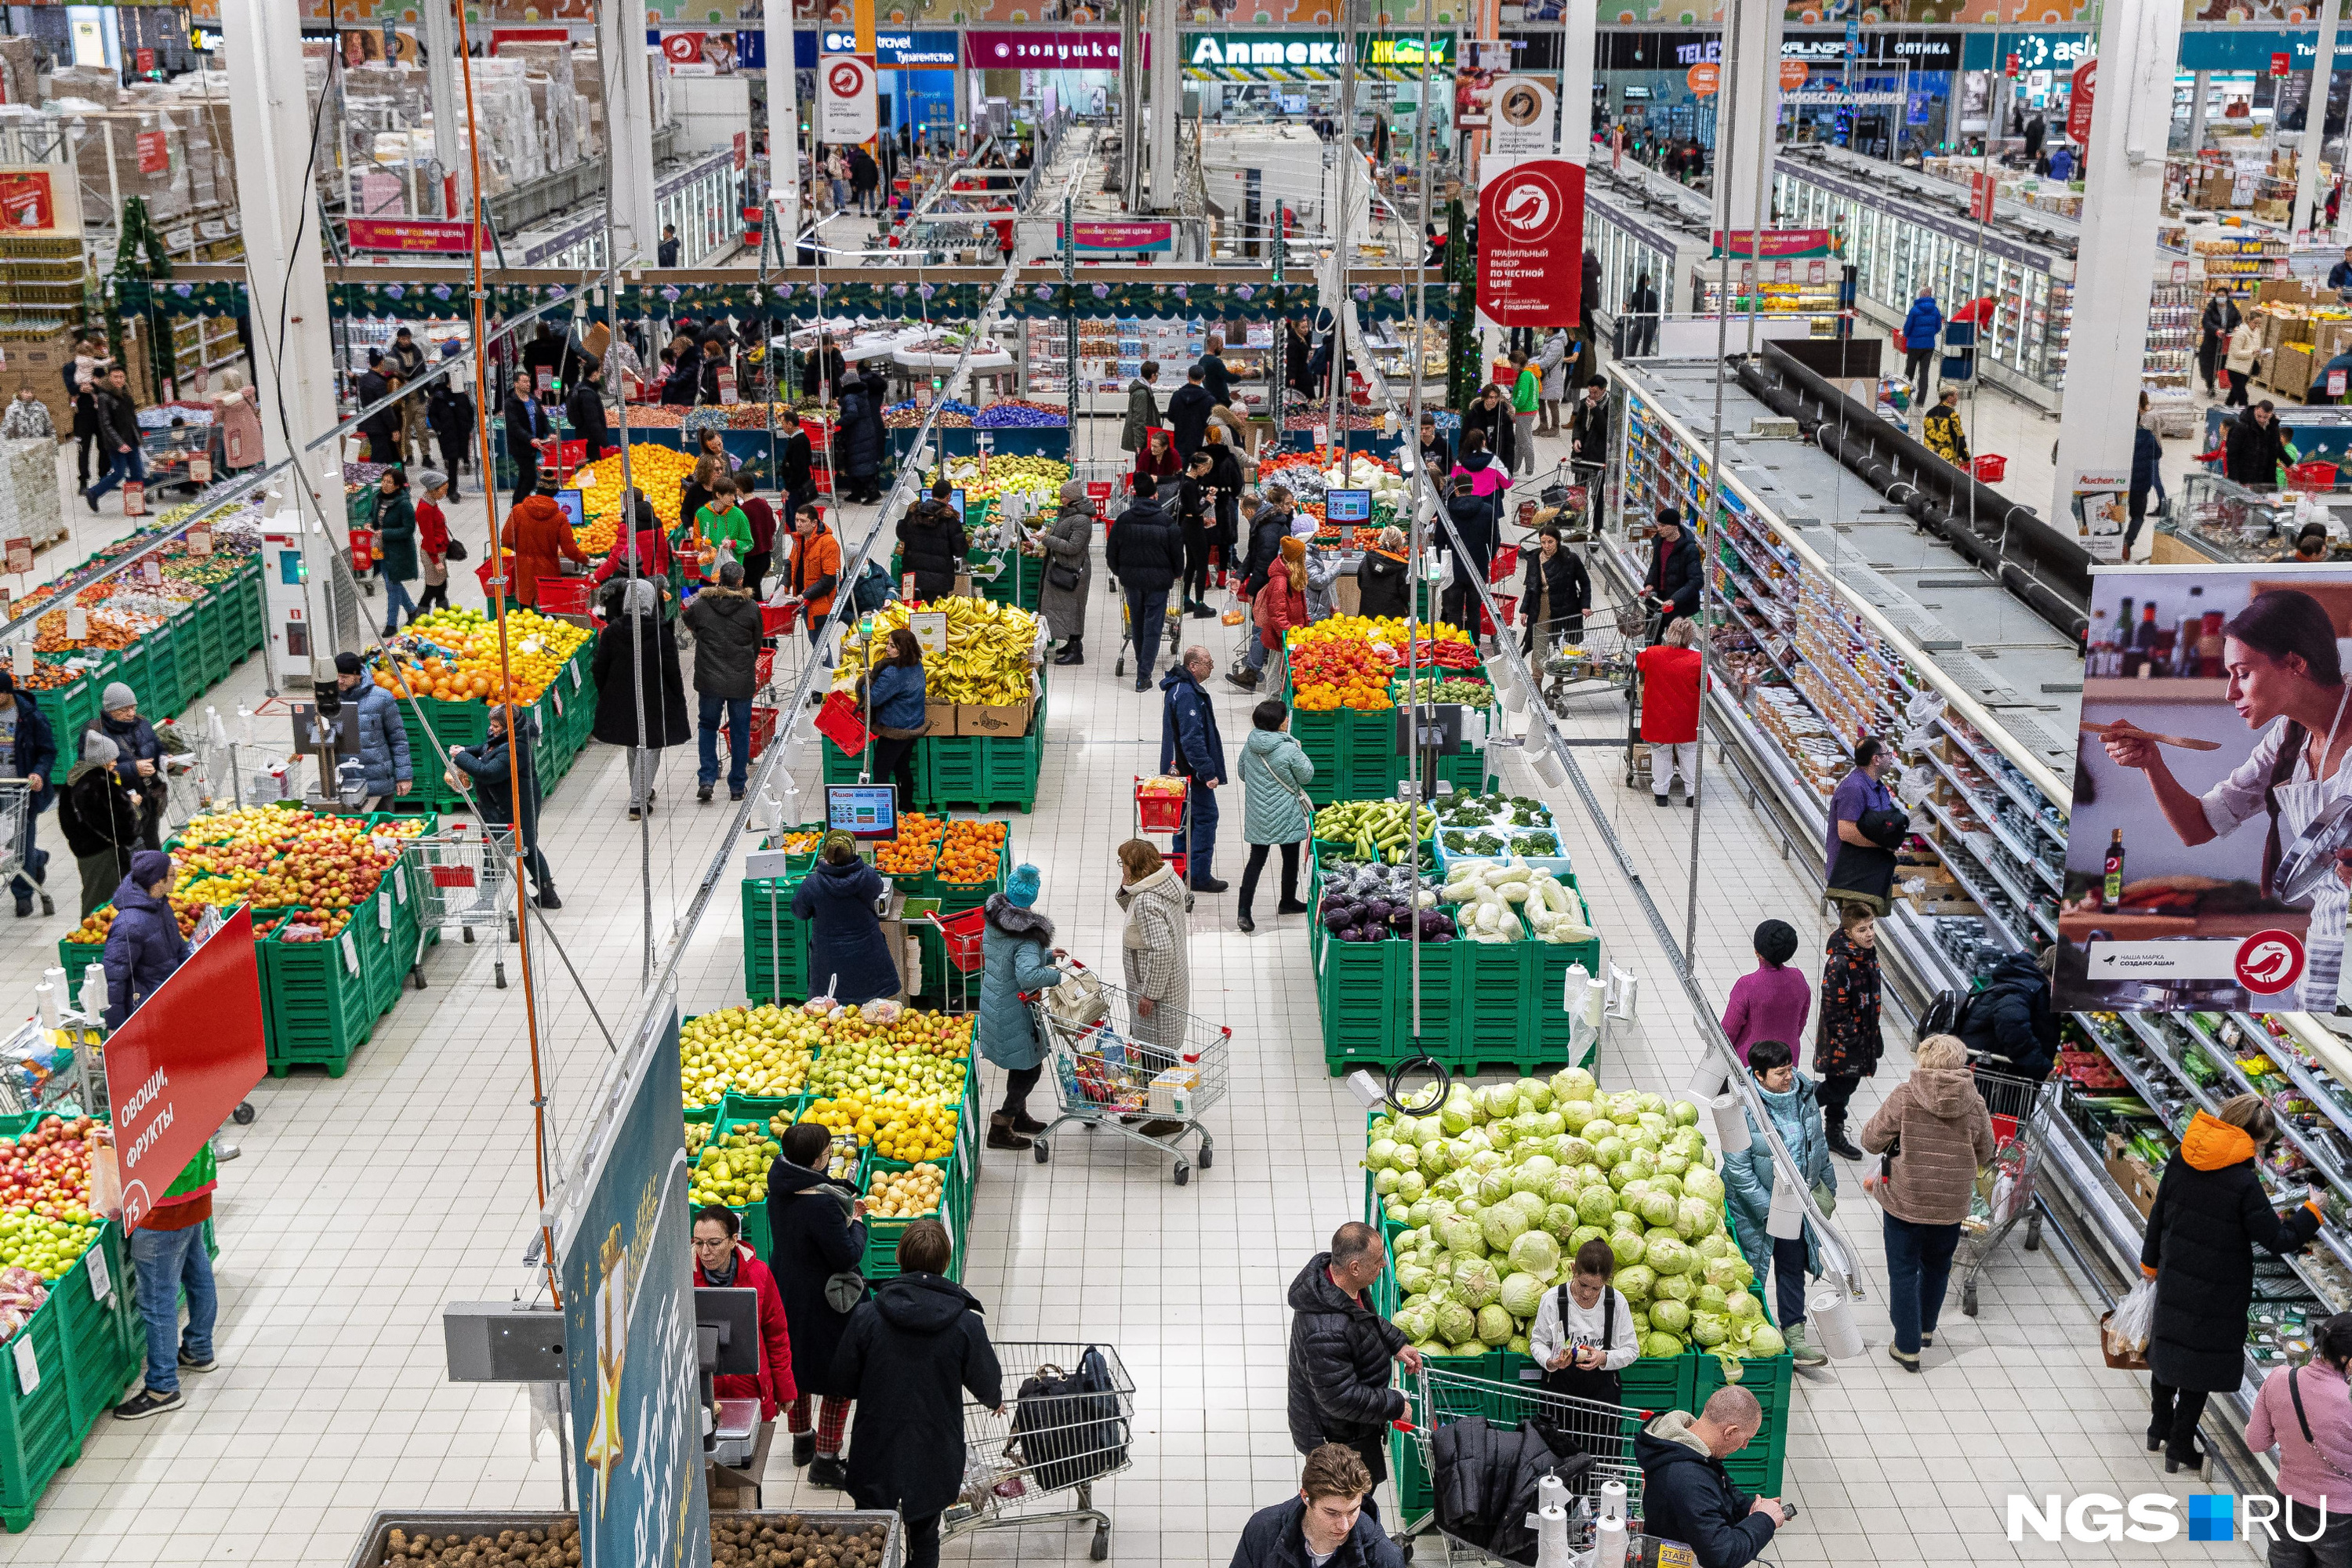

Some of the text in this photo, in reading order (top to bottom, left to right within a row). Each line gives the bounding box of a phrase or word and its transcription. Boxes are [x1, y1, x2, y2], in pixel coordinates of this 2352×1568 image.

[877, 35, 911, 49] travel
[1894, 42, 1951, 55] ОПТИКА
[895, 50, 954, 64] Турагентство
[1016, 42, 1119, 60] золушка
[1191, 37, 1357, 64] Аптека
[1490, 249, 1548, 258] ПРАВИЛЬНЫЙ
[1504, 268, 1544, 278] ЧЕСТНОЙ
[1490, 280, 1512, 289] ЦЕНЕ
[121, 1065, 169, 1128] ОВОЩИ,
[125, 1102, 175, 1169] ФРУКТЫ
[126, 1196, 140, 1229] 75
[1662, 1550, 1691, 1561] START
